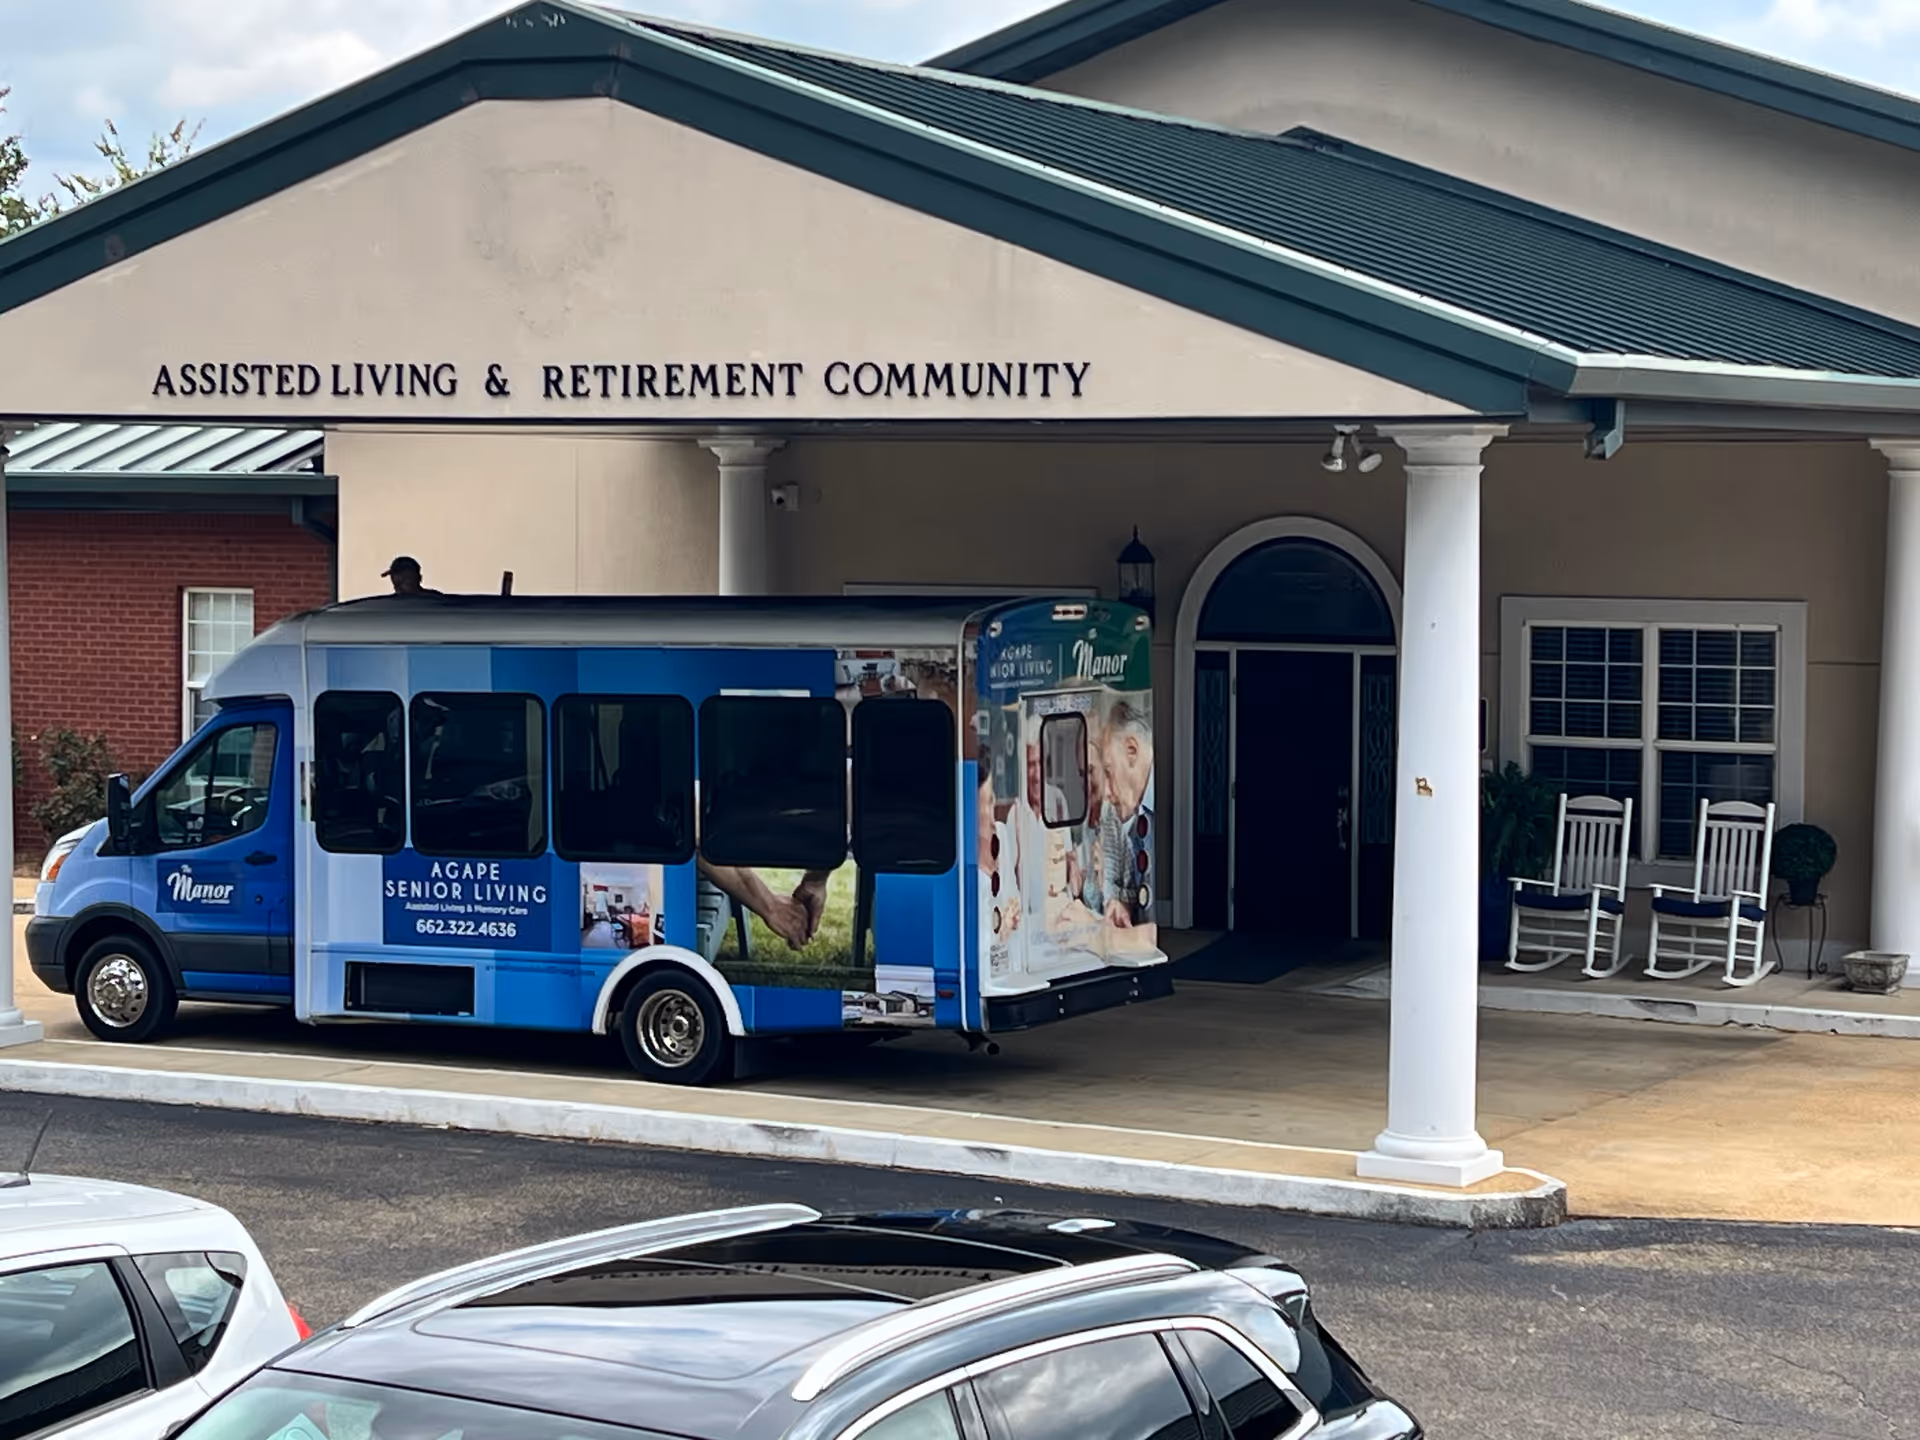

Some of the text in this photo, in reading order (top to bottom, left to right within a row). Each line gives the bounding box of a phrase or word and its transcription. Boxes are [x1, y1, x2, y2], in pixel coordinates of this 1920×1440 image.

[152, 361, 1091, 398] ASSISTED LIVING & RETIREMENT COMMUNITY
[1020, 660, 1053, 676] LIVING
[1072, 640, 1127, 680] Manor
[431, 861, 500, 880] AGAPE
[167, 872, 234, 902] Manor
[385, 880, 547, 903] SENIOR LIVING
[404, 902, 439, 911] Assisted
[440, 904, 465, 914] Living
[474, 905, 507, 915] Memory
[508, 906, 528, 915] Care
[415, 919, 517, 937] 662.322.4636
